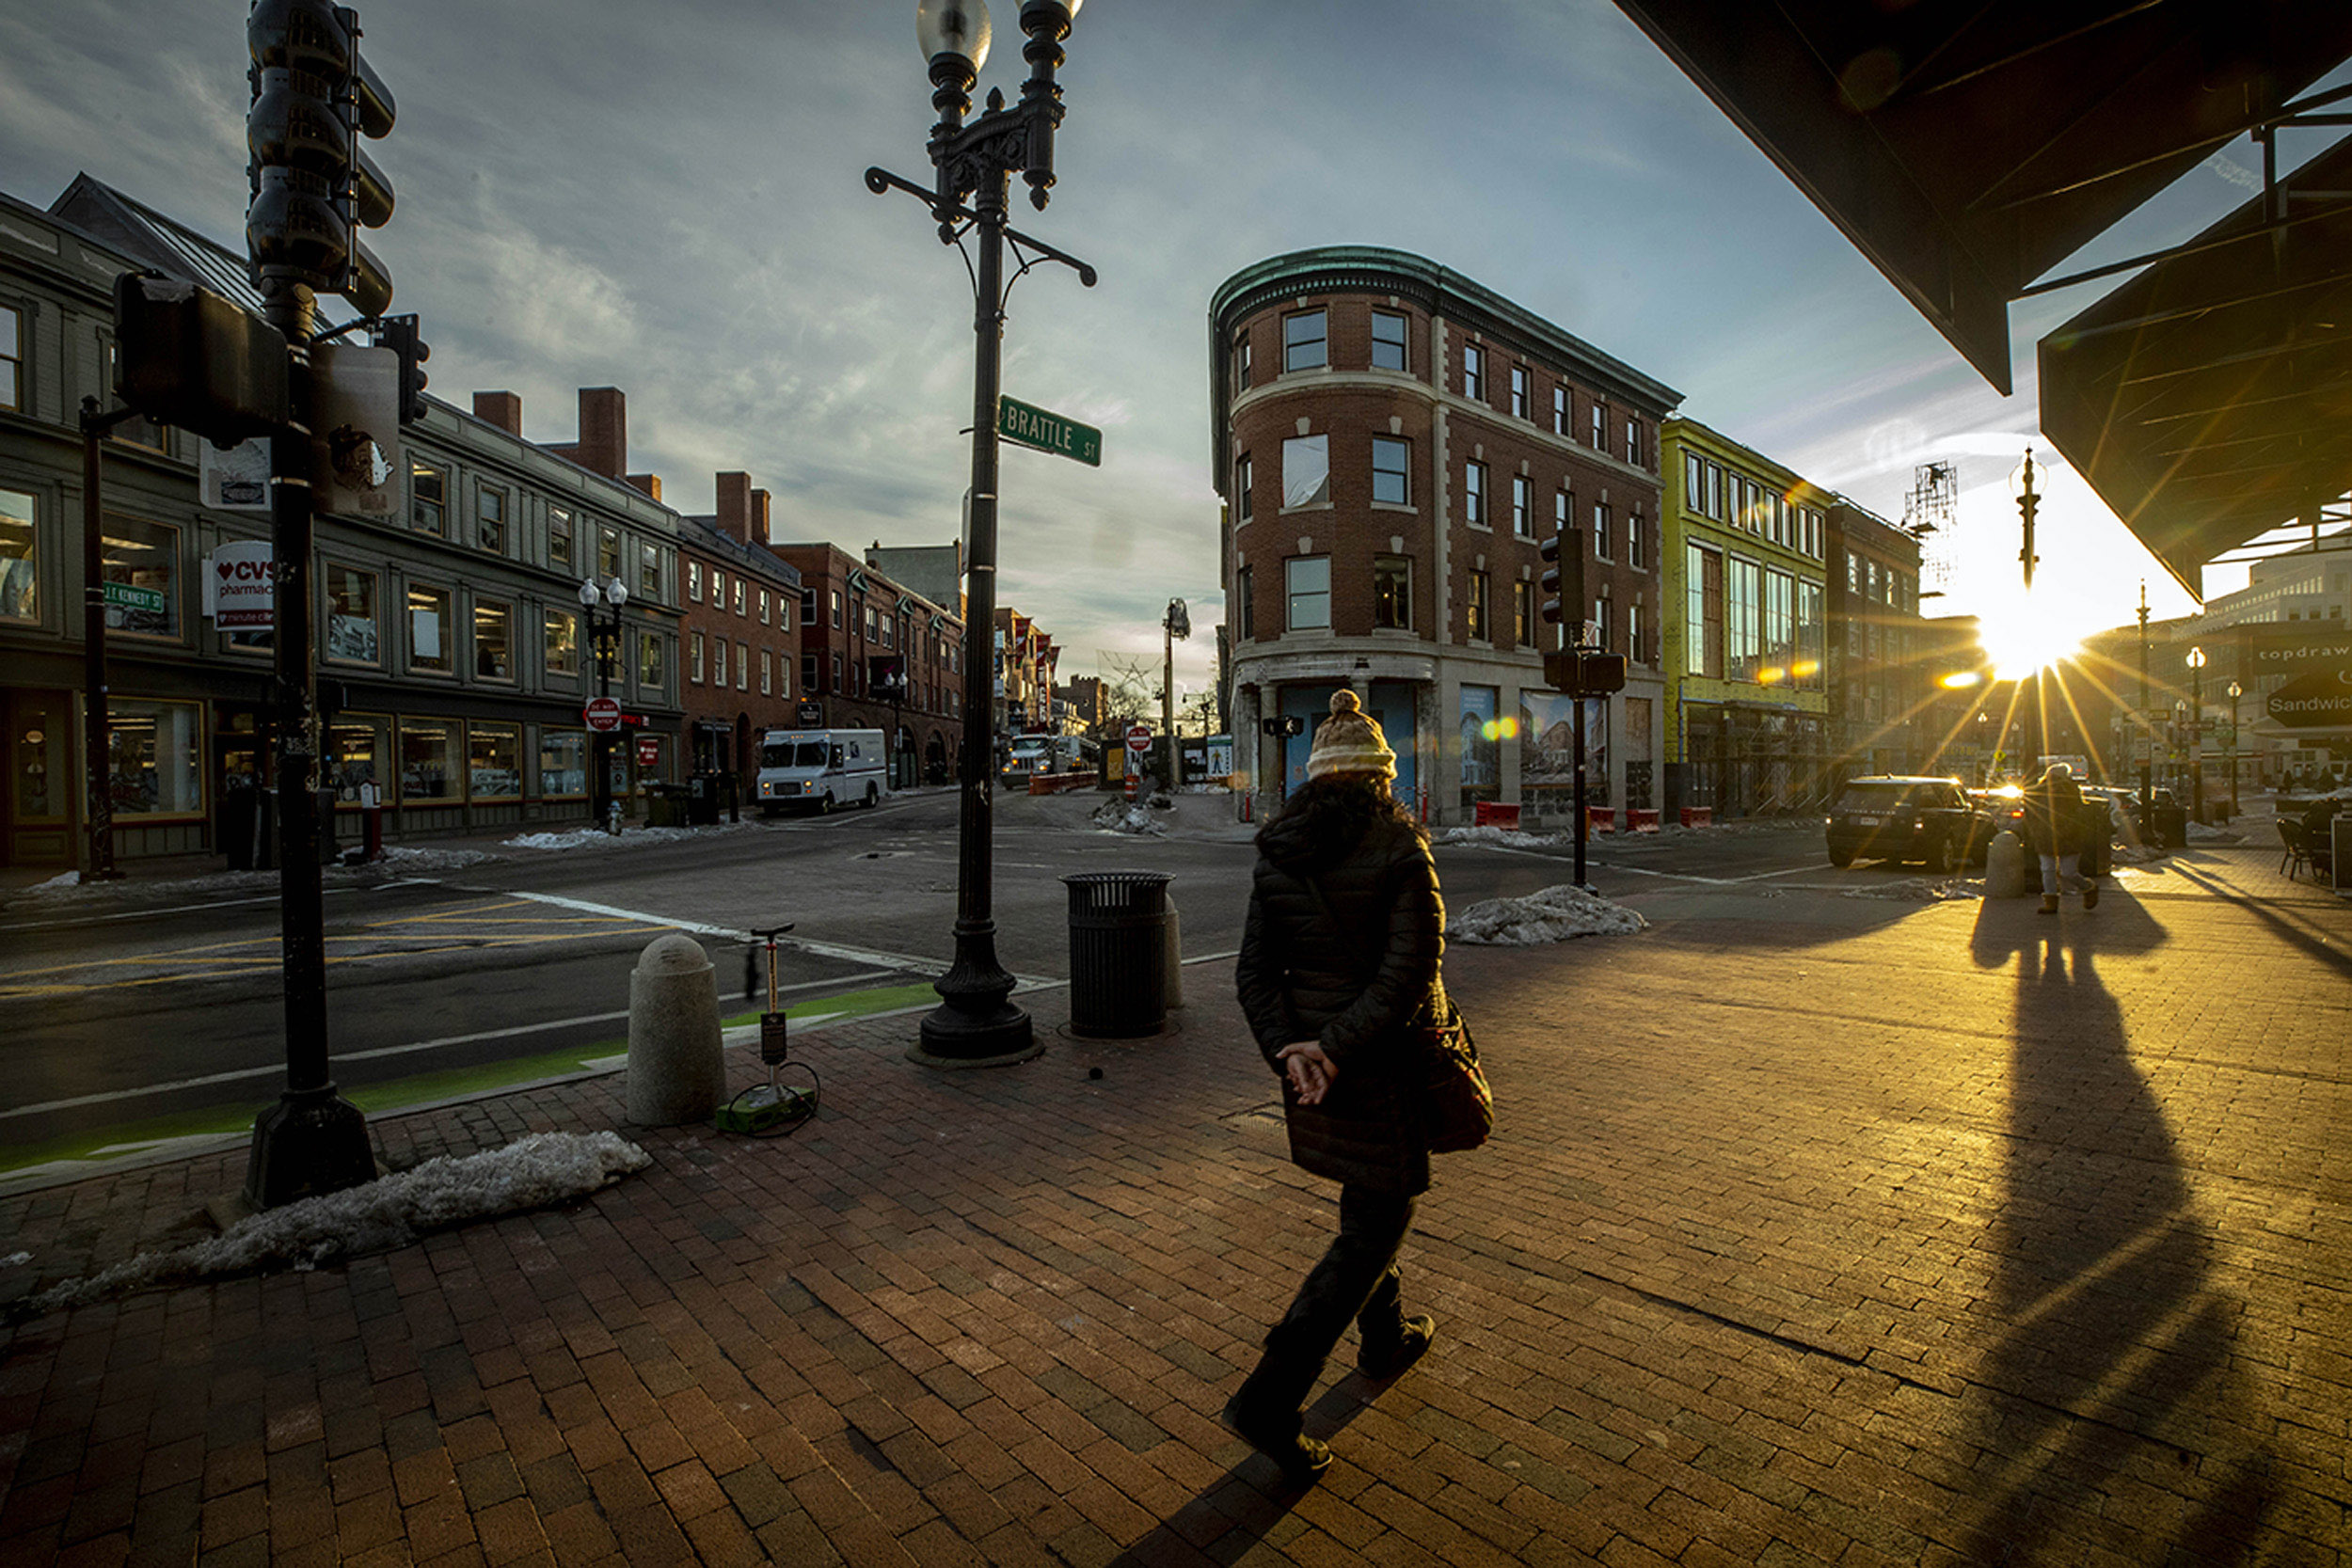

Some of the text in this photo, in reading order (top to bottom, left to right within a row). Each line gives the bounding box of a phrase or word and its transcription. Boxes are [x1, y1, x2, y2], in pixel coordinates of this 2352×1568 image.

[1007, 405, 1095, 457] BRATTLE ST
[235, 561, 273, 580] CVS
[119, 589, 150, 605] KENNEDY
[2269, 696, 2352, 712] Sandwic
